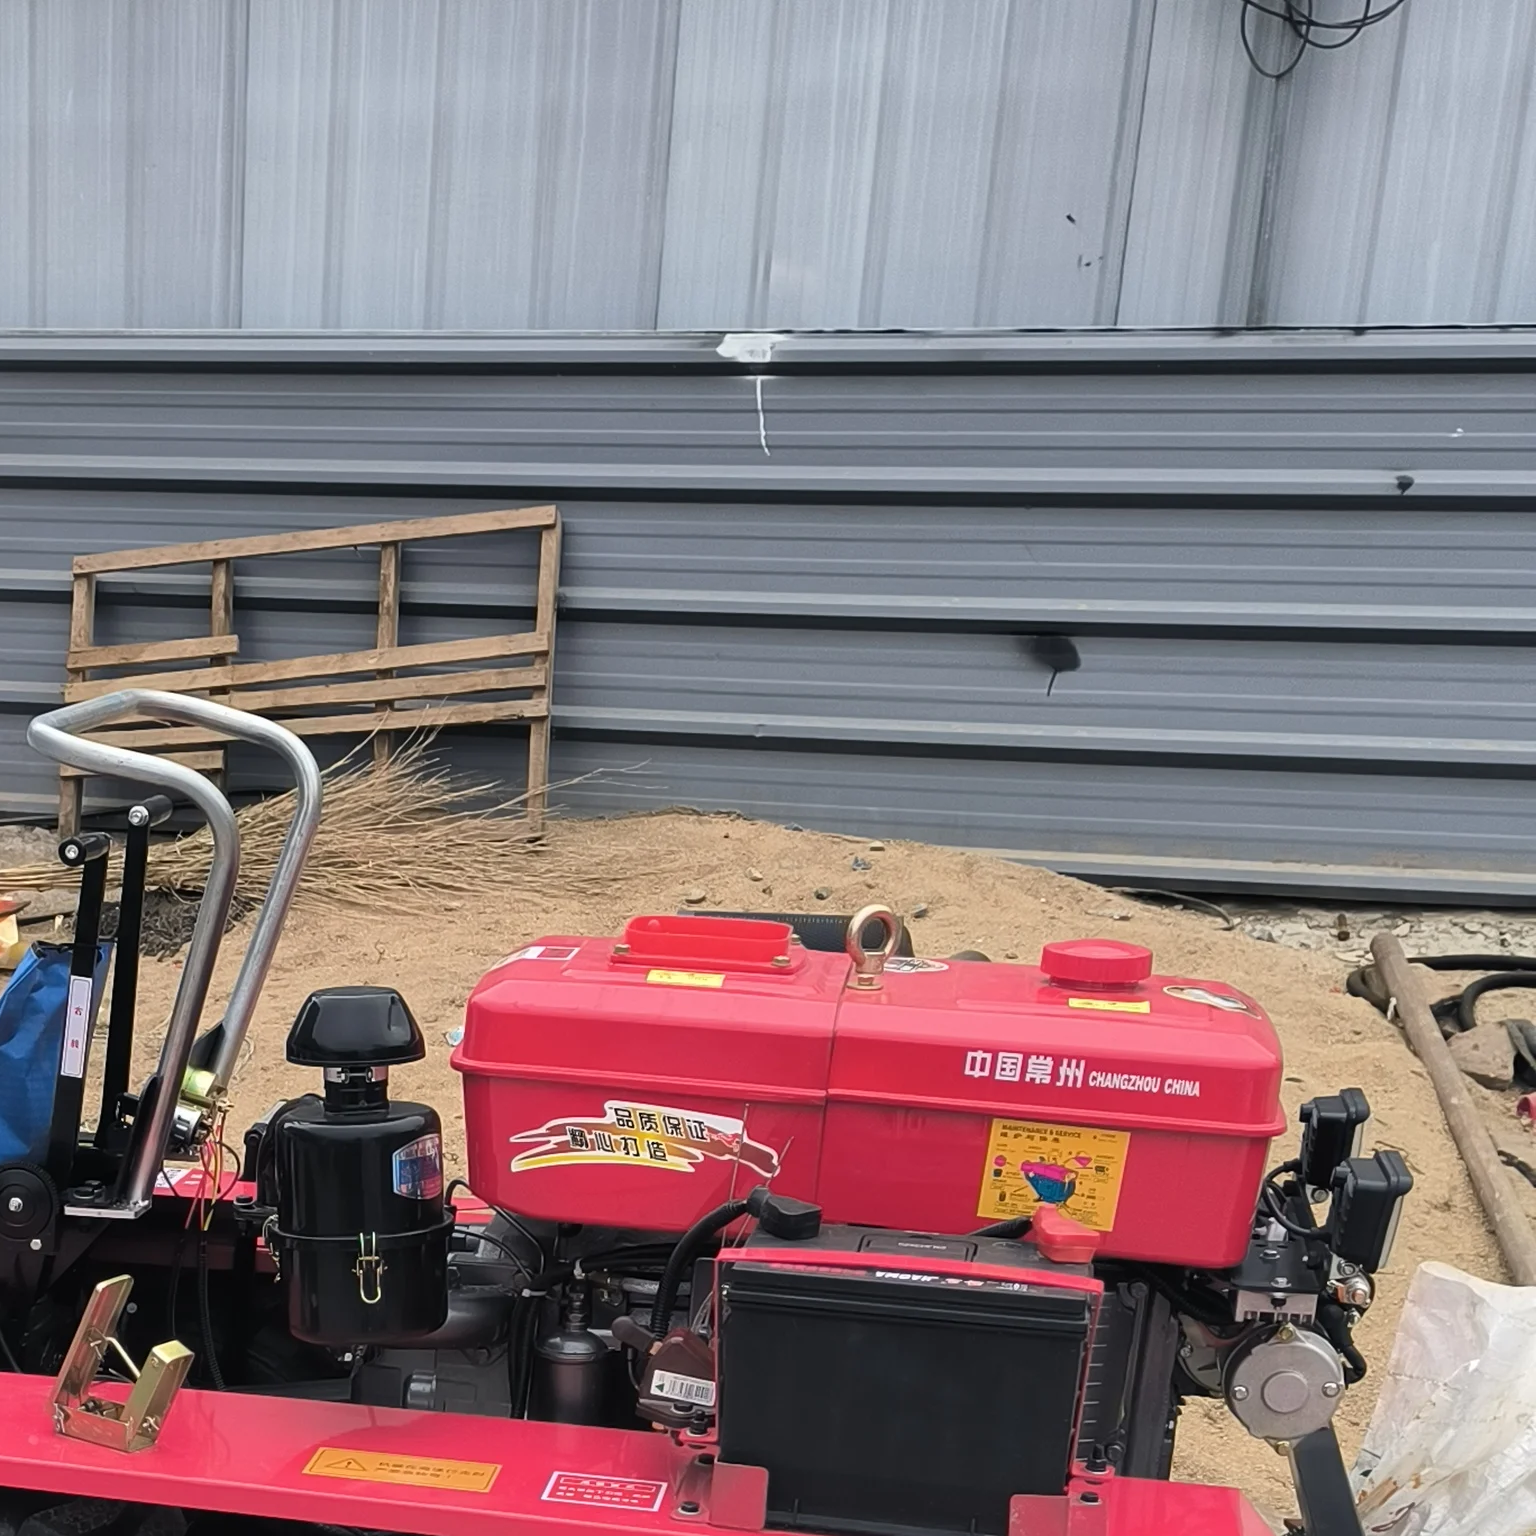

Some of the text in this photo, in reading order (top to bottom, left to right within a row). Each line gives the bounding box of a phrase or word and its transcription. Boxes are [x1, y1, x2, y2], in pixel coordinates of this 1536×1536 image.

[965, 1050, 1086, 1088] 中国常州
[1089, 1070, 1200, 1097] CHANGZHOU CHINA
[614, 1107, 709, 1141] 品质保证
